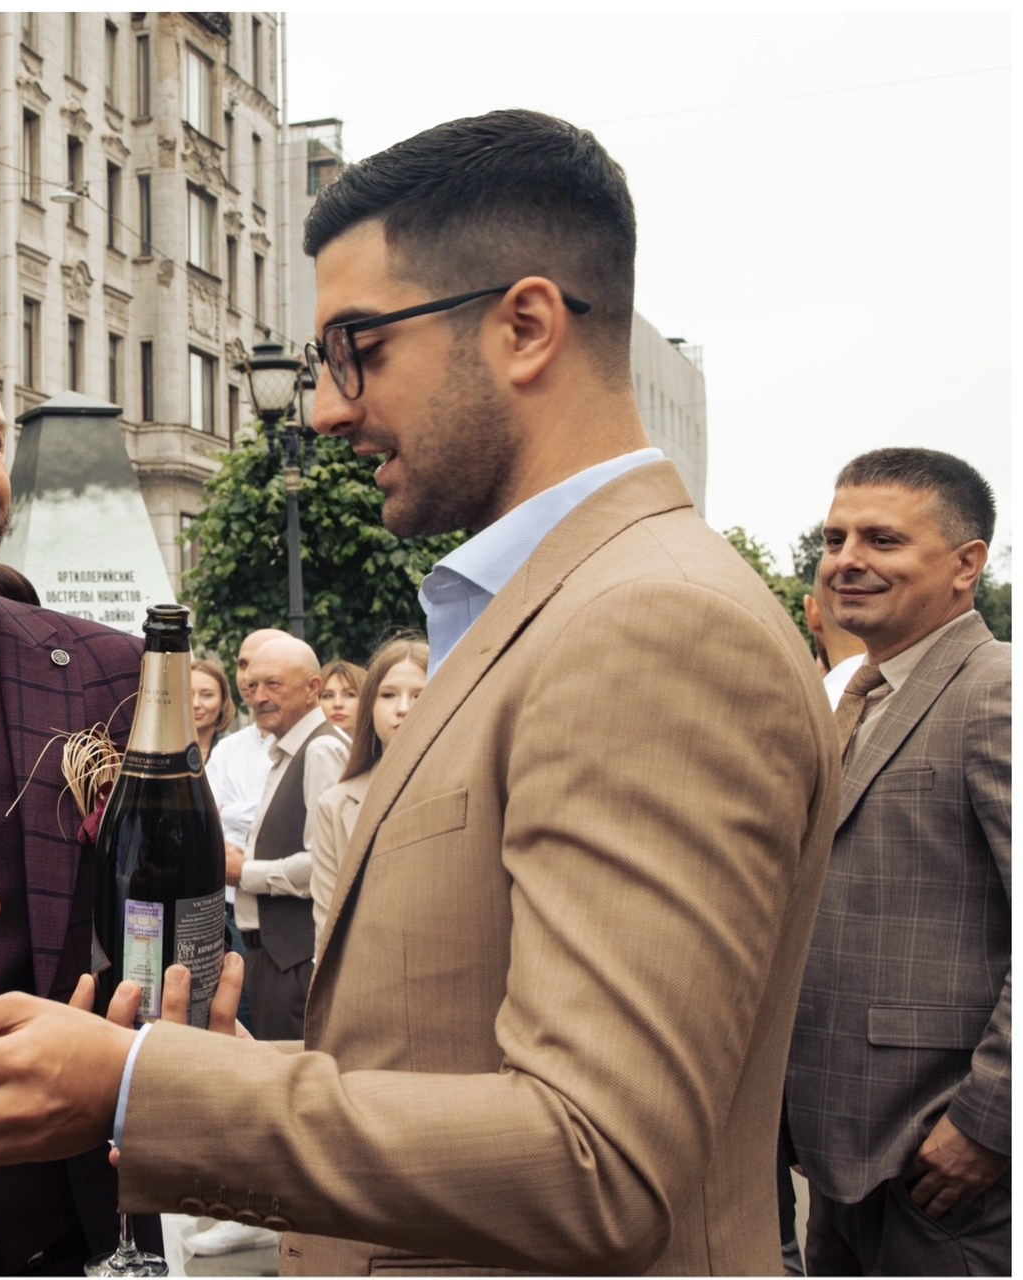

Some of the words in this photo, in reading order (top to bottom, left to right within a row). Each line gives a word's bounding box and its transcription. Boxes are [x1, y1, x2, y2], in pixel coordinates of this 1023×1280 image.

[57, 569, 135, 583] АРТИЛЛЕРИЙСКИЕ
[46, 590, 94, 603] ОБСТРЕЛЫ
[98, 590, 141, 604] НАЦИСТОВ
